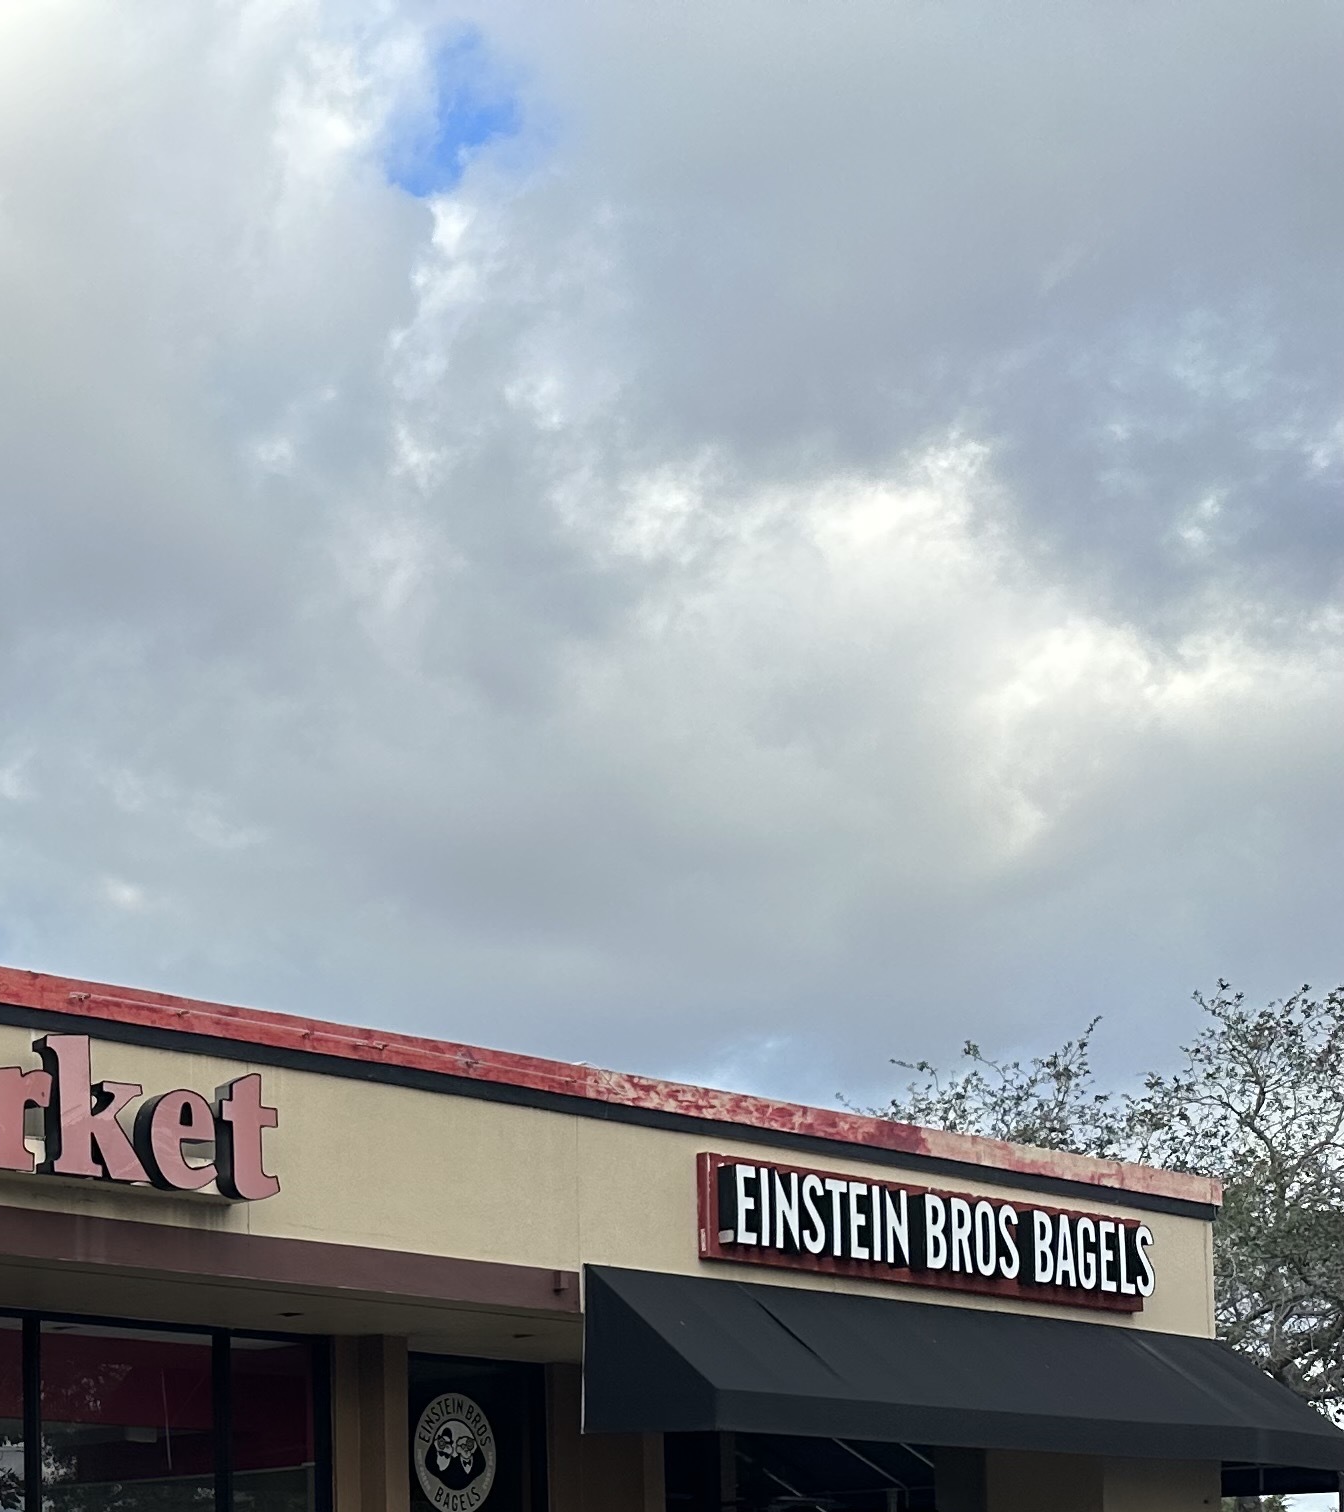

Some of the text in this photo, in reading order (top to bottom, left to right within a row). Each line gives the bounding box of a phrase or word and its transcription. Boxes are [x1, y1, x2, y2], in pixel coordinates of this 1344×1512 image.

[734, 1163, 1156, 1298] EINSTEIN BROS BAGELS
[418, 1398, 491, 1447] EINSTEIN BROS
[434, 1486, 481, 1512] BAGELS
